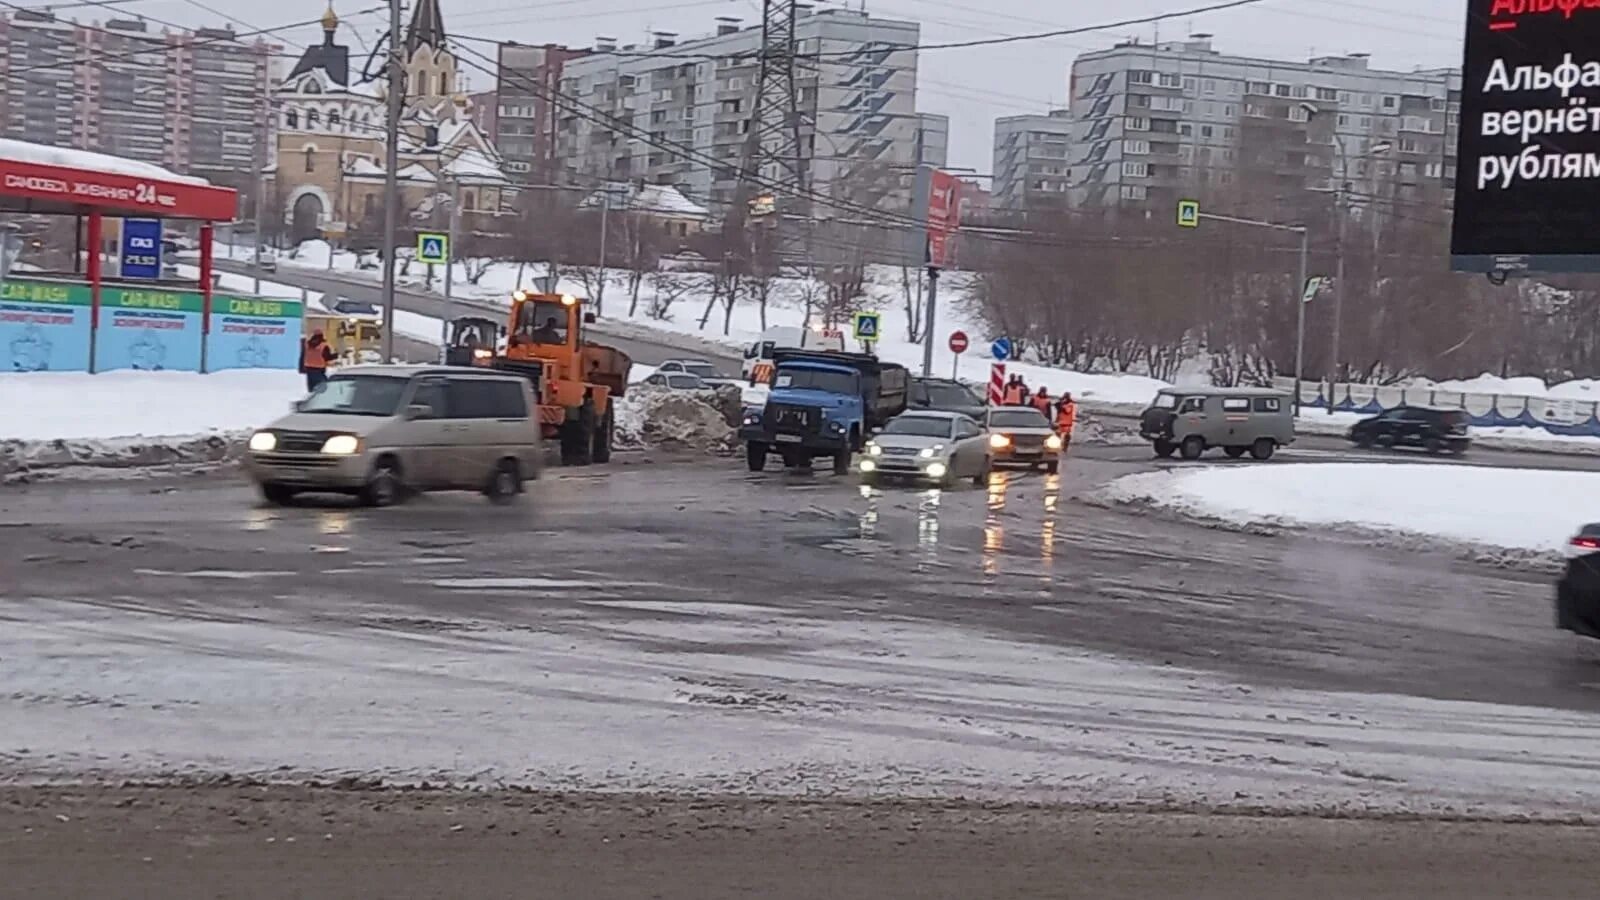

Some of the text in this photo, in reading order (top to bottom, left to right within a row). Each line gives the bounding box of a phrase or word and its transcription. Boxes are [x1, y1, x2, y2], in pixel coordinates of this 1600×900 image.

[1483, 53, 1600, 97] Альфа
[1481, 97, 1600, 144] вернёт
[135, 183, 156, 204] 24
[121, 291, 180, 309] CAR-WASH
[229, 299, 282, 316] CAR-WASH
